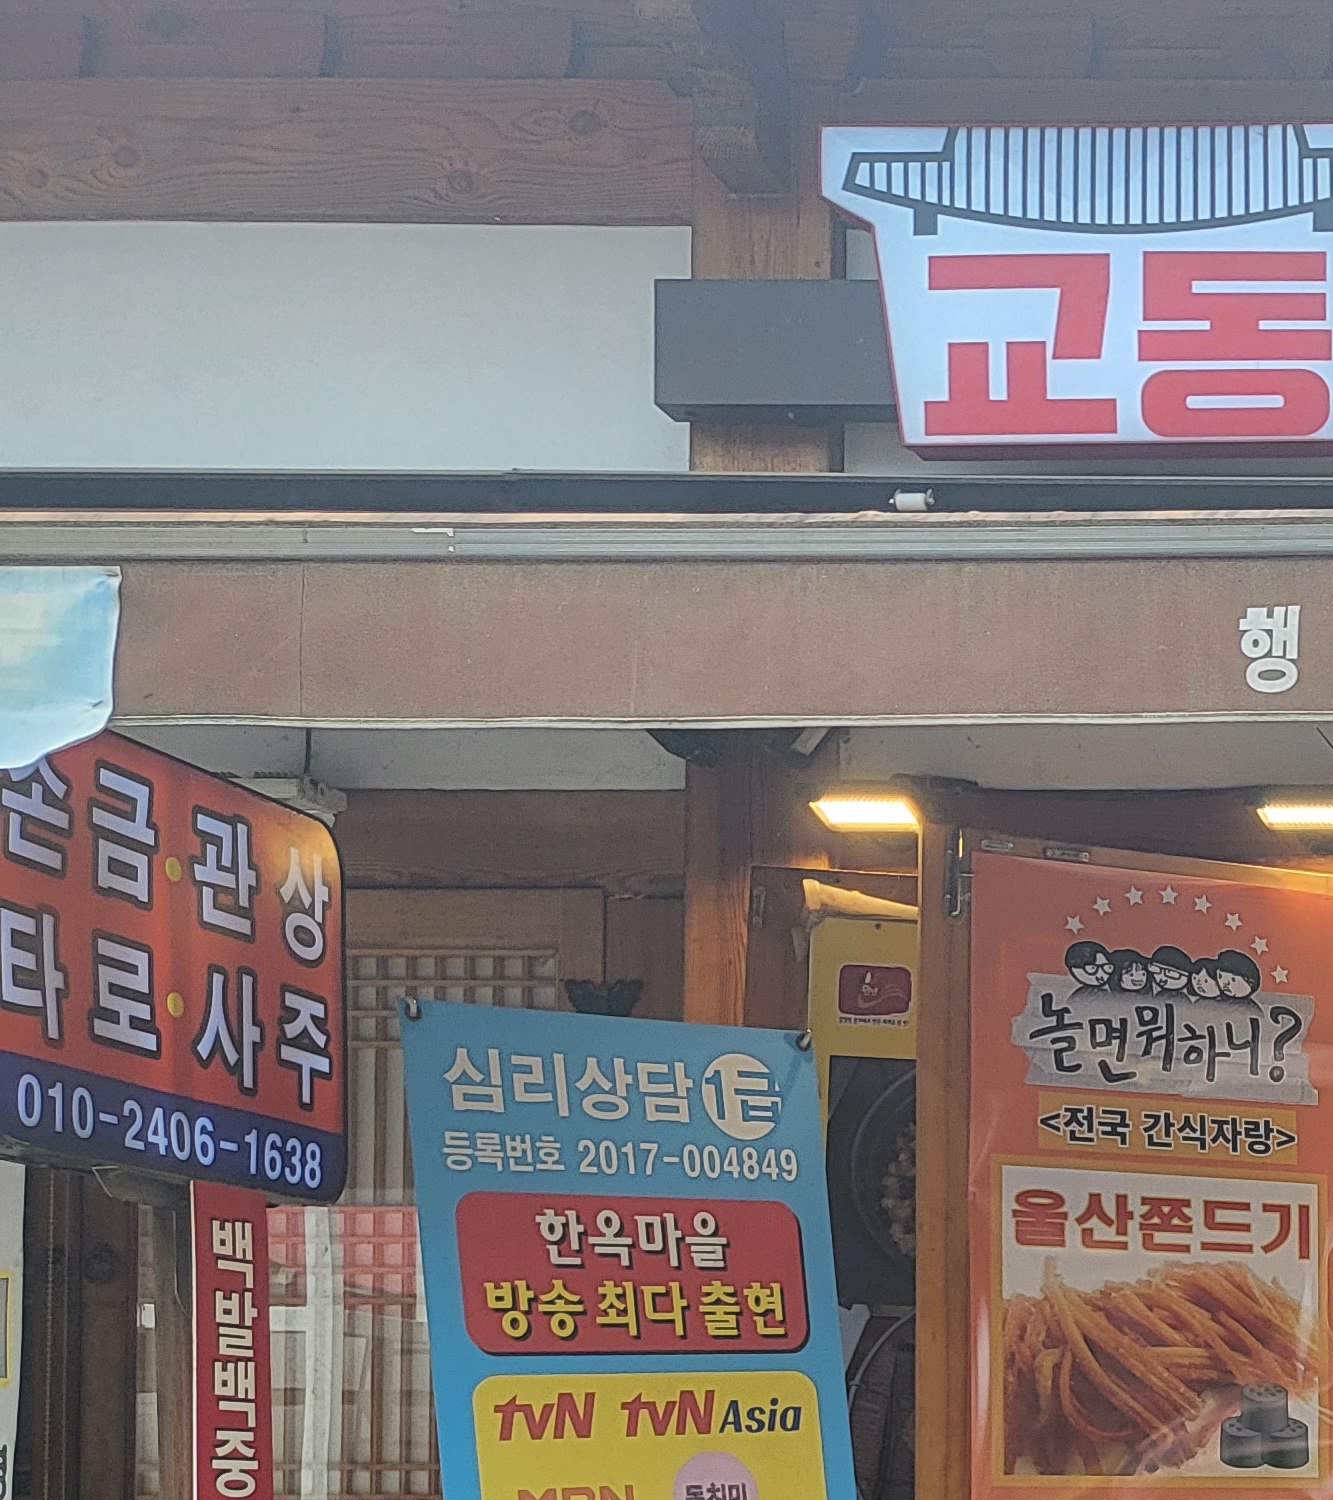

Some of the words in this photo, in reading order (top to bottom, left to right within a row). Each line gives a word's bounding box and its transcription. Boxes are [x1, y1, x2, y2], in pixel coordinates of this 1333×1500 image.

[924, 250, 1333, 438] 교동
[443, 1047, 692, 1123] 심리상담
[17, 1073, 324, 1189] 010-2406-1638
[442, 1131, 564, 1173] 등록번호
[577, 1139, 798, 1182] 2017-004849
[535, 1208, 727, 1268] 한옥마을
[1011, 1188, 1313, 1261] 울산쫀드기
[484, 1279, 586, 1339] 방송
[596, 1279, 690, 1338] 최다
[698, 1281, 787, 1338] 출현
[210, 1219, 260, 1499] 백발백중
[493, 1391, 596, 1441] tvN
[621, 1389, 715, 1437] tvN
[718, 1397, 803, 1434] Asia
